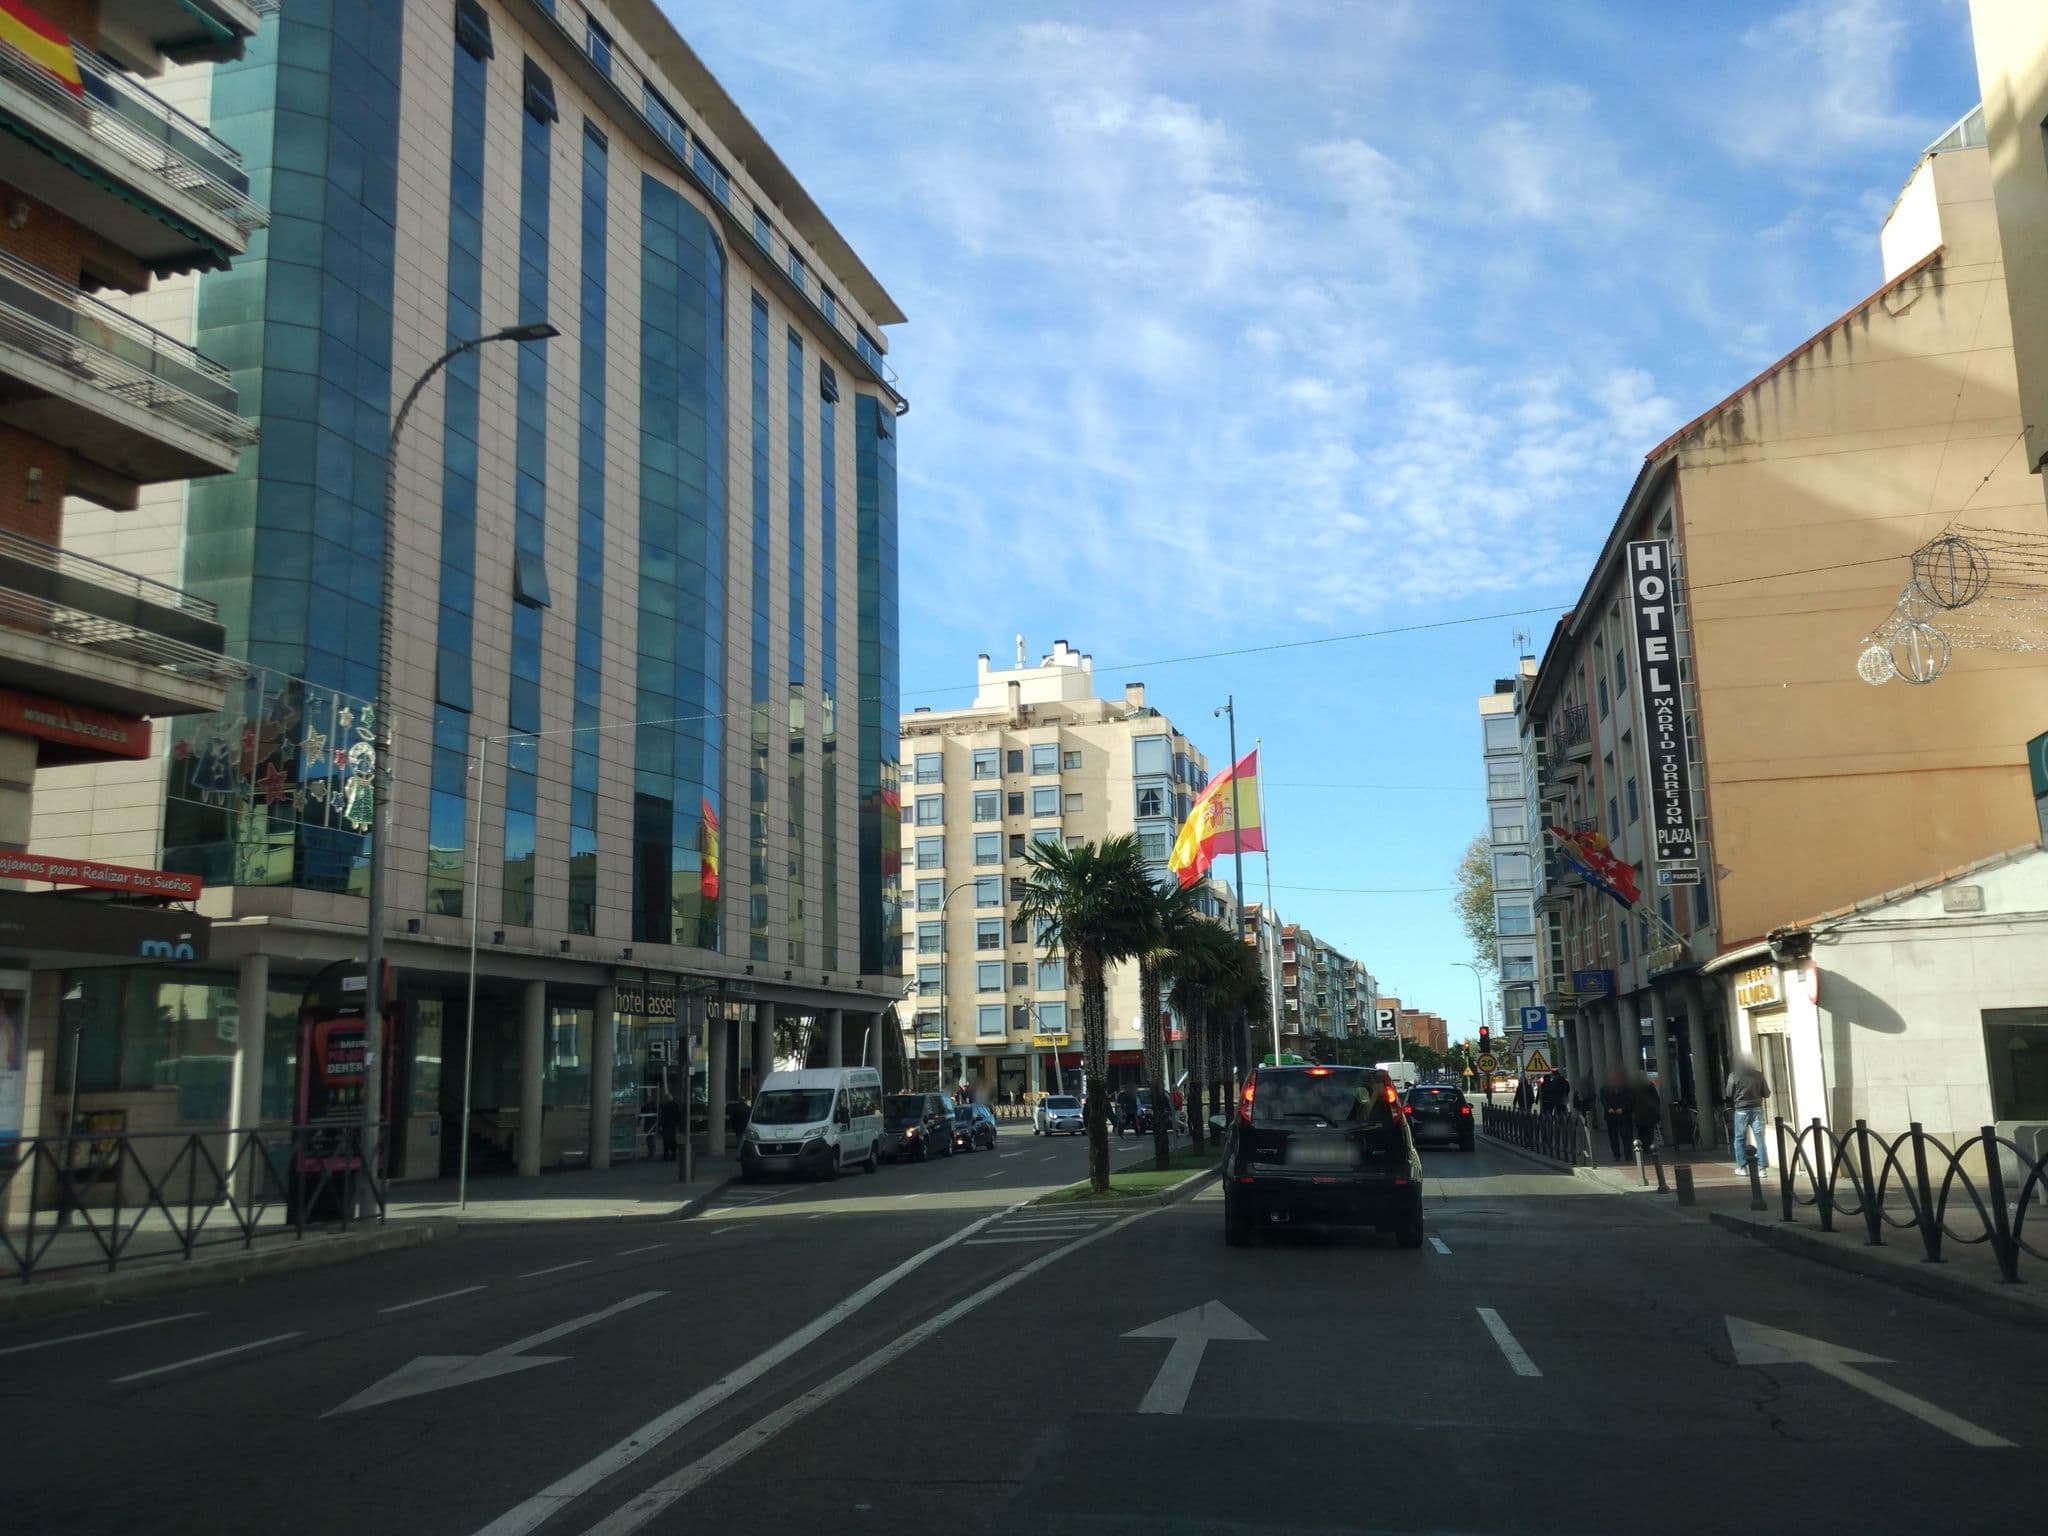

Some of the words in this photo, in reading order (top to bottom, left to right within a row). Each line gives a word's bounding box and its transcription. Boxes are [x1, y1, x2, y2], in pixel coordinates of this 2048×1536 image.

[1637, 546, 1671, 693] HOTEL
[1654, 697, 1676, 749] MADRID
[1661, 754, 1683, 825] TORREJON
[1658, 828, 1693, 844] PLAZA
[48, 863, 78, 878] para
[82, 865, 131, 882] Realizar
[133, 873, 151, 886] tus
[154, 875, 193, 892] Sueños
[615, 985, 645, 1013] hotel
[1526, 1009, 1541, 1029] P
